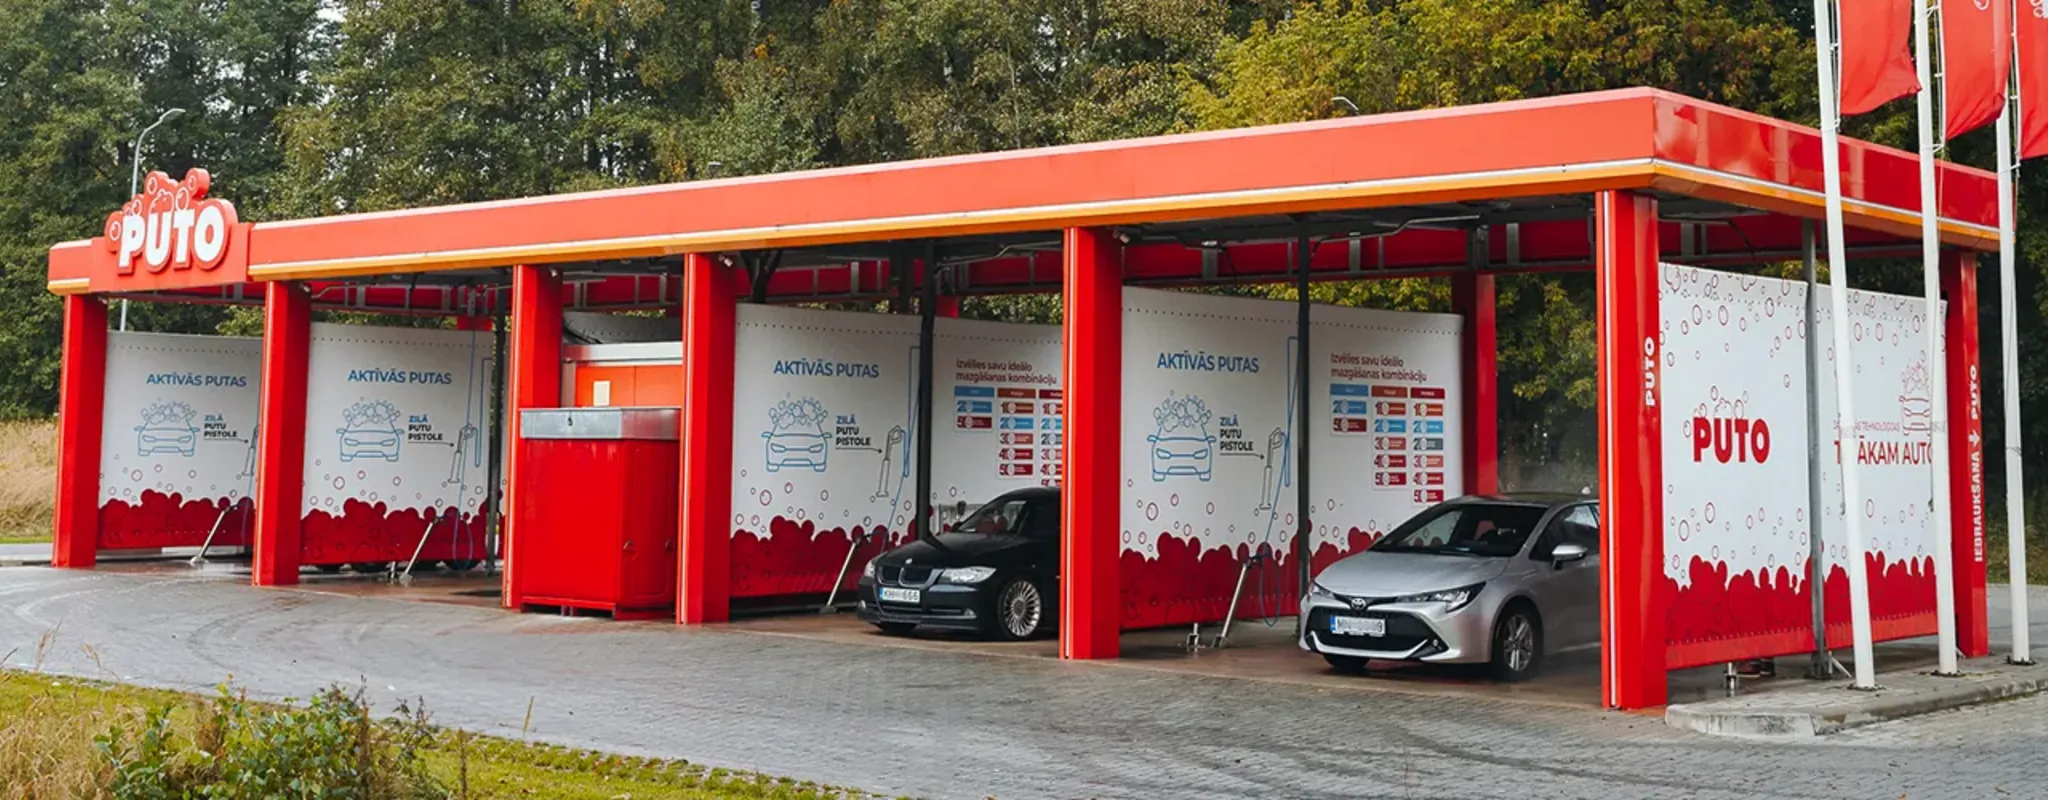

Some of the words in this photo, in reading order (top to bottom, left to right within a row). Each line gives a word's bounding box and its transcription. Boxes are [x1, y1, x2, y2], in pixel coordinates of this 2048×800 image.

[118, 205, 224, 267] PUTO
[1157, 350, 1215, 371] AKTĪVĀS
[1217, 355, 1260, 373] PUTAS
[774, 358, 833, 377] AKTĪVĀS
[836, 363, 879, 378] PUTAS
[1644, 336, 1656, 407] PUTO
[147, 372, 202, 386] AKTĪVĀS
[205, 376, 247, 388] PUTAS
[348, 367, 406, 383] AKTĪVĀS
[409, 372, 453, 385] PUTAS
[204, 413, 223, 421] ZILĀ
[409, 414, 428, 423] ZILĀ
[836, 414, 855, 425] ZILĀ
[1220, 414, 1238, 427] ZILĀ
[409, 424, 431, 432] PUTU
[836, 427, 859, 435] PUTU
[408, 433, 443, 441] PISTOLE
[1220, 429, 1241, 439] PUTU
[836, 437, 870, 446] PISTOLE
[1693, 416, 1770, 464] PUTO
[1220, 441, 1253, 451] PISTOLE
